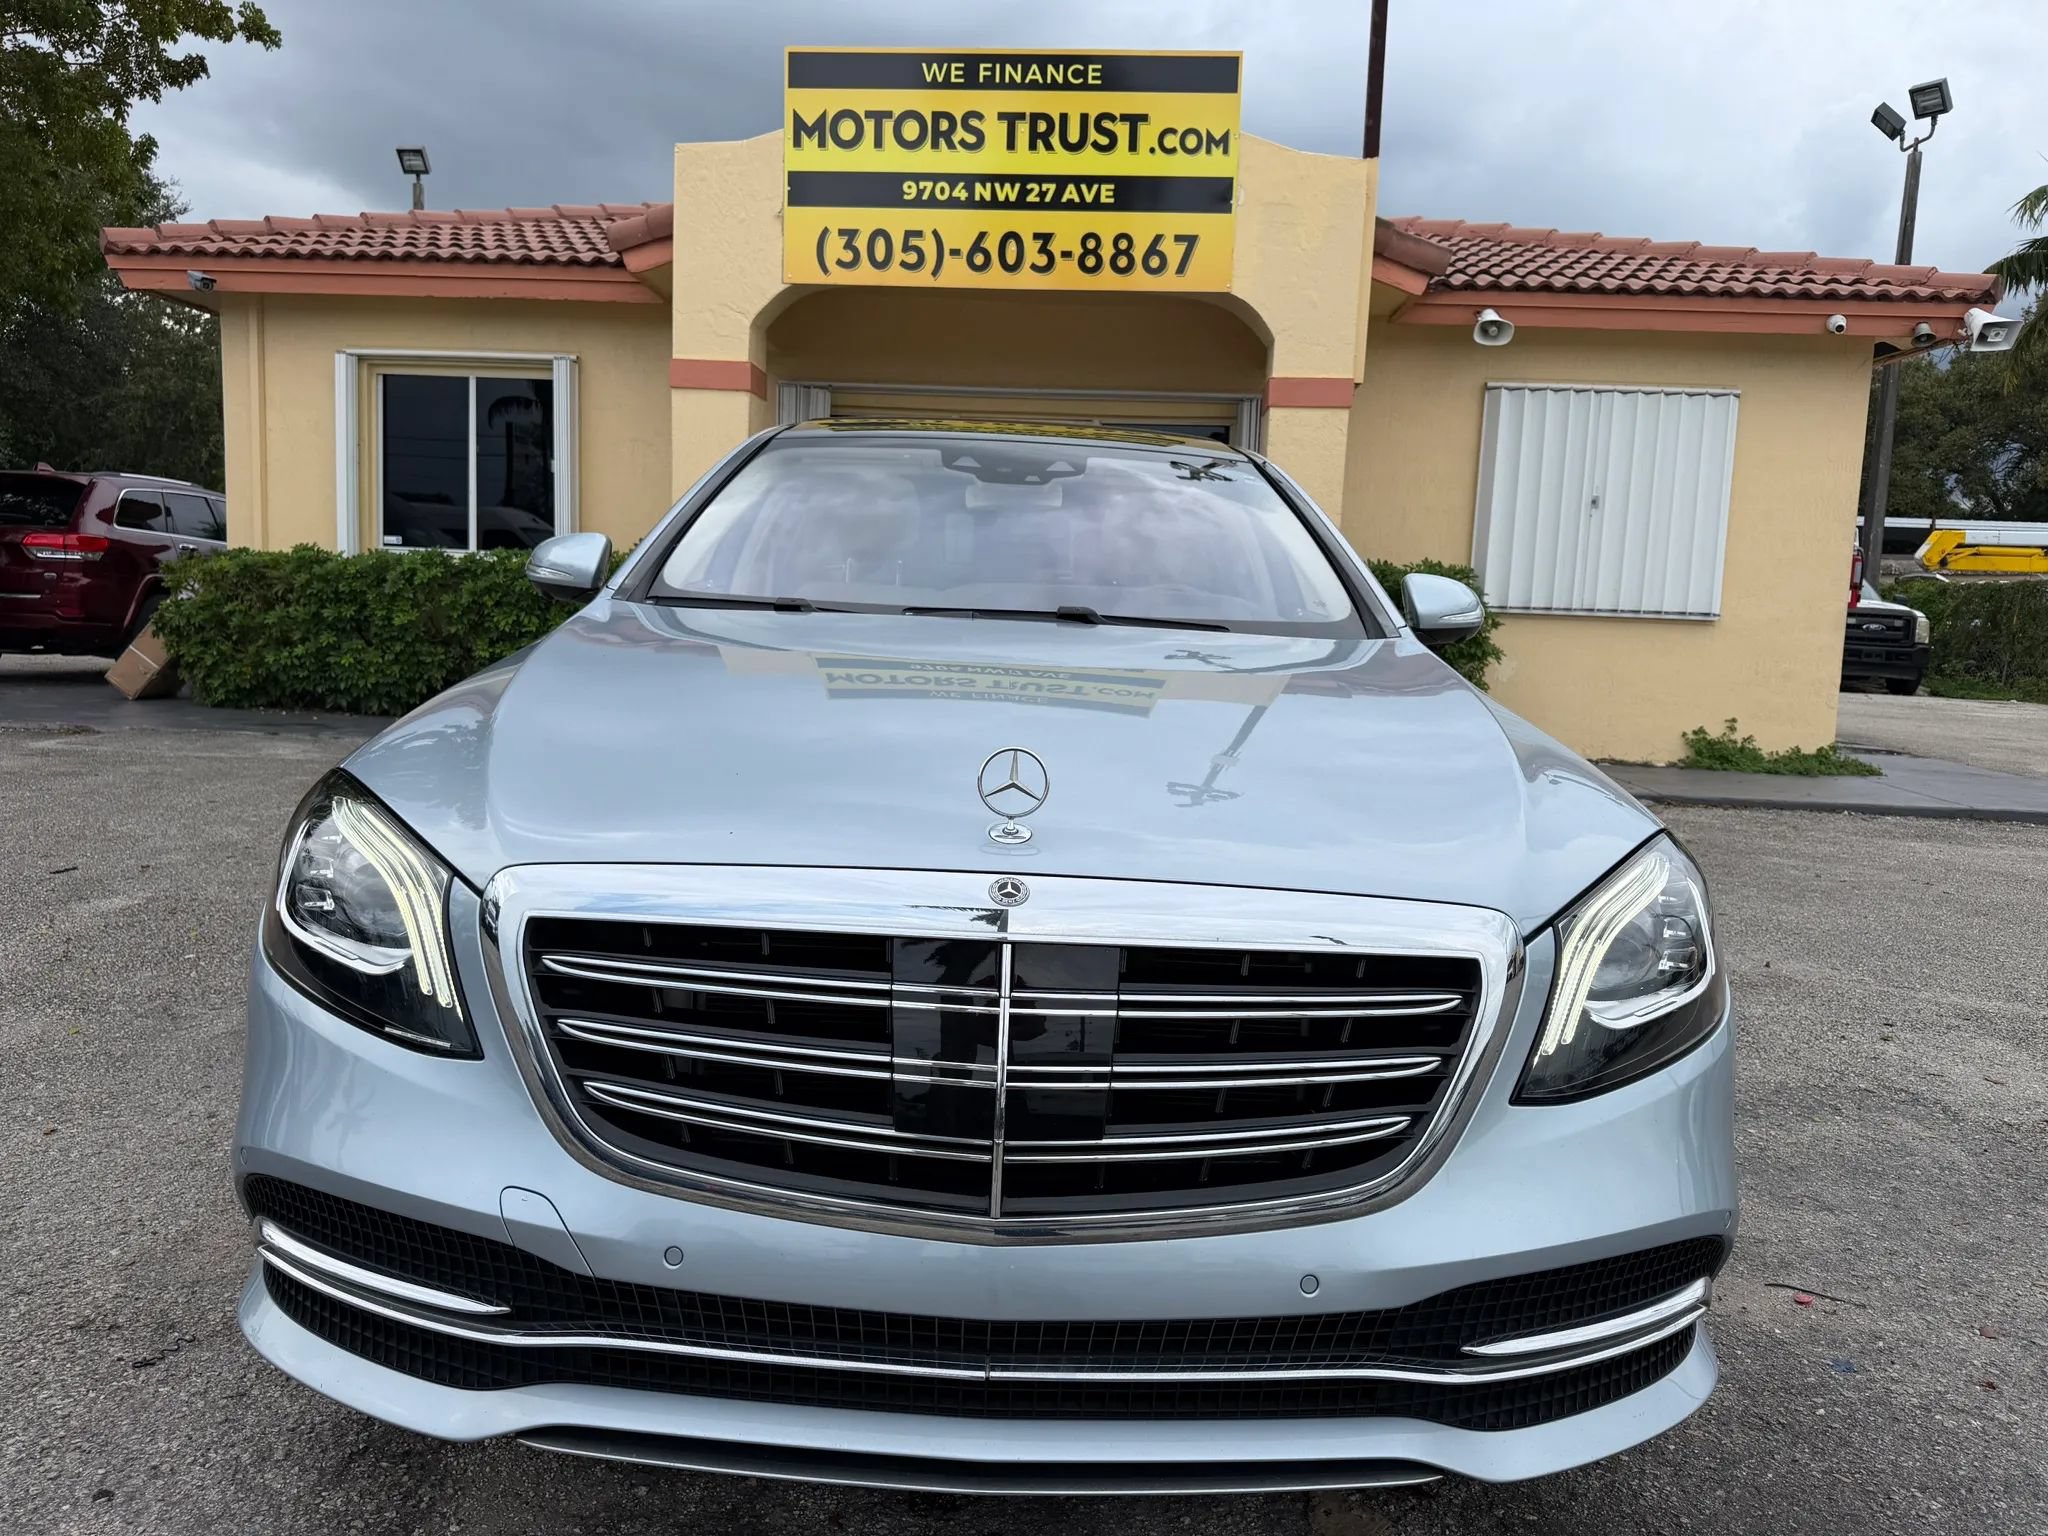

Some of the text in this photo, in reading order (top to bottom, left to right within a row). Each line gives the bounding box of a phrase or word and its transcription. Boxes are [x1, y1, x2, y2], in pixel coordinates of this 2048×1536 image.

[922, 62, 1103, 85] WE FINANCE
[792, 108, 1230, 156] MOTORS TRUST.COM
[902, 181, 1115, 204] 9704 NW 27 AVE
[816, 226, 1200, 281] (305)-603-8867
